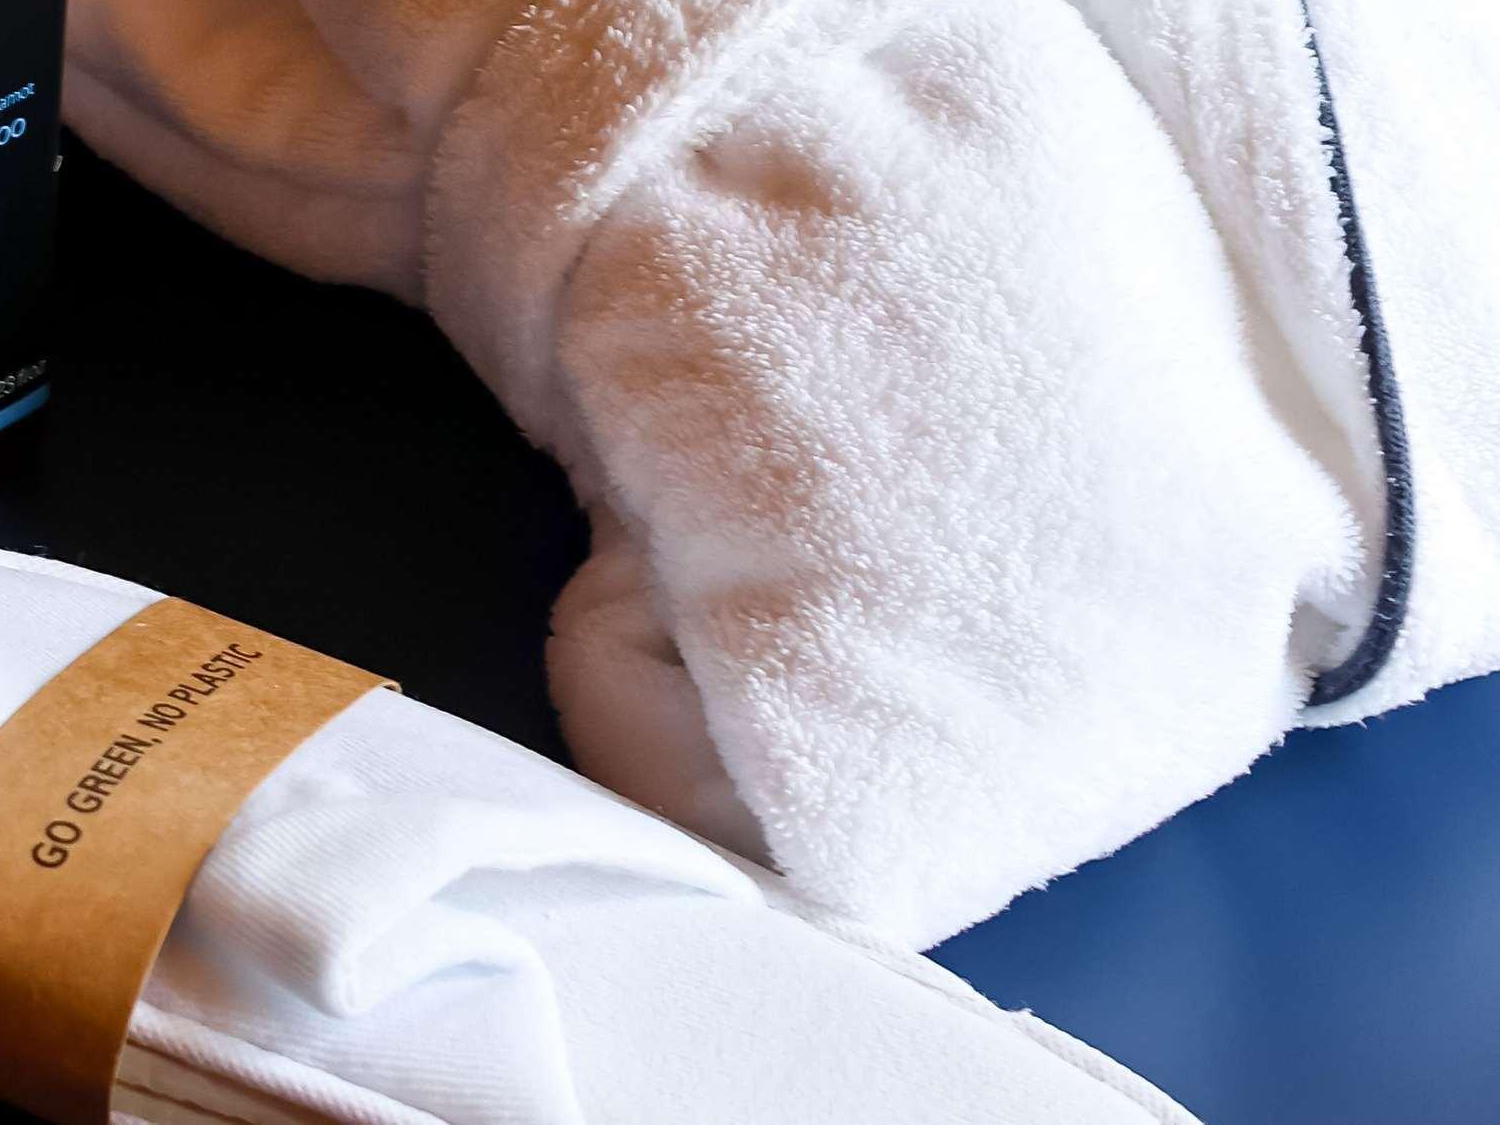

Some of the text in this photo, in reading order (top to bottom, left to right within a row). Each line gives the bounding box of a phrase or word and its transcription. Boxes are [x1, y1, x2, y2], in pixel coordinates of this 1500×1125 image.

[31, 643, 263, 869] GO GREEN, NO PLASTIC
